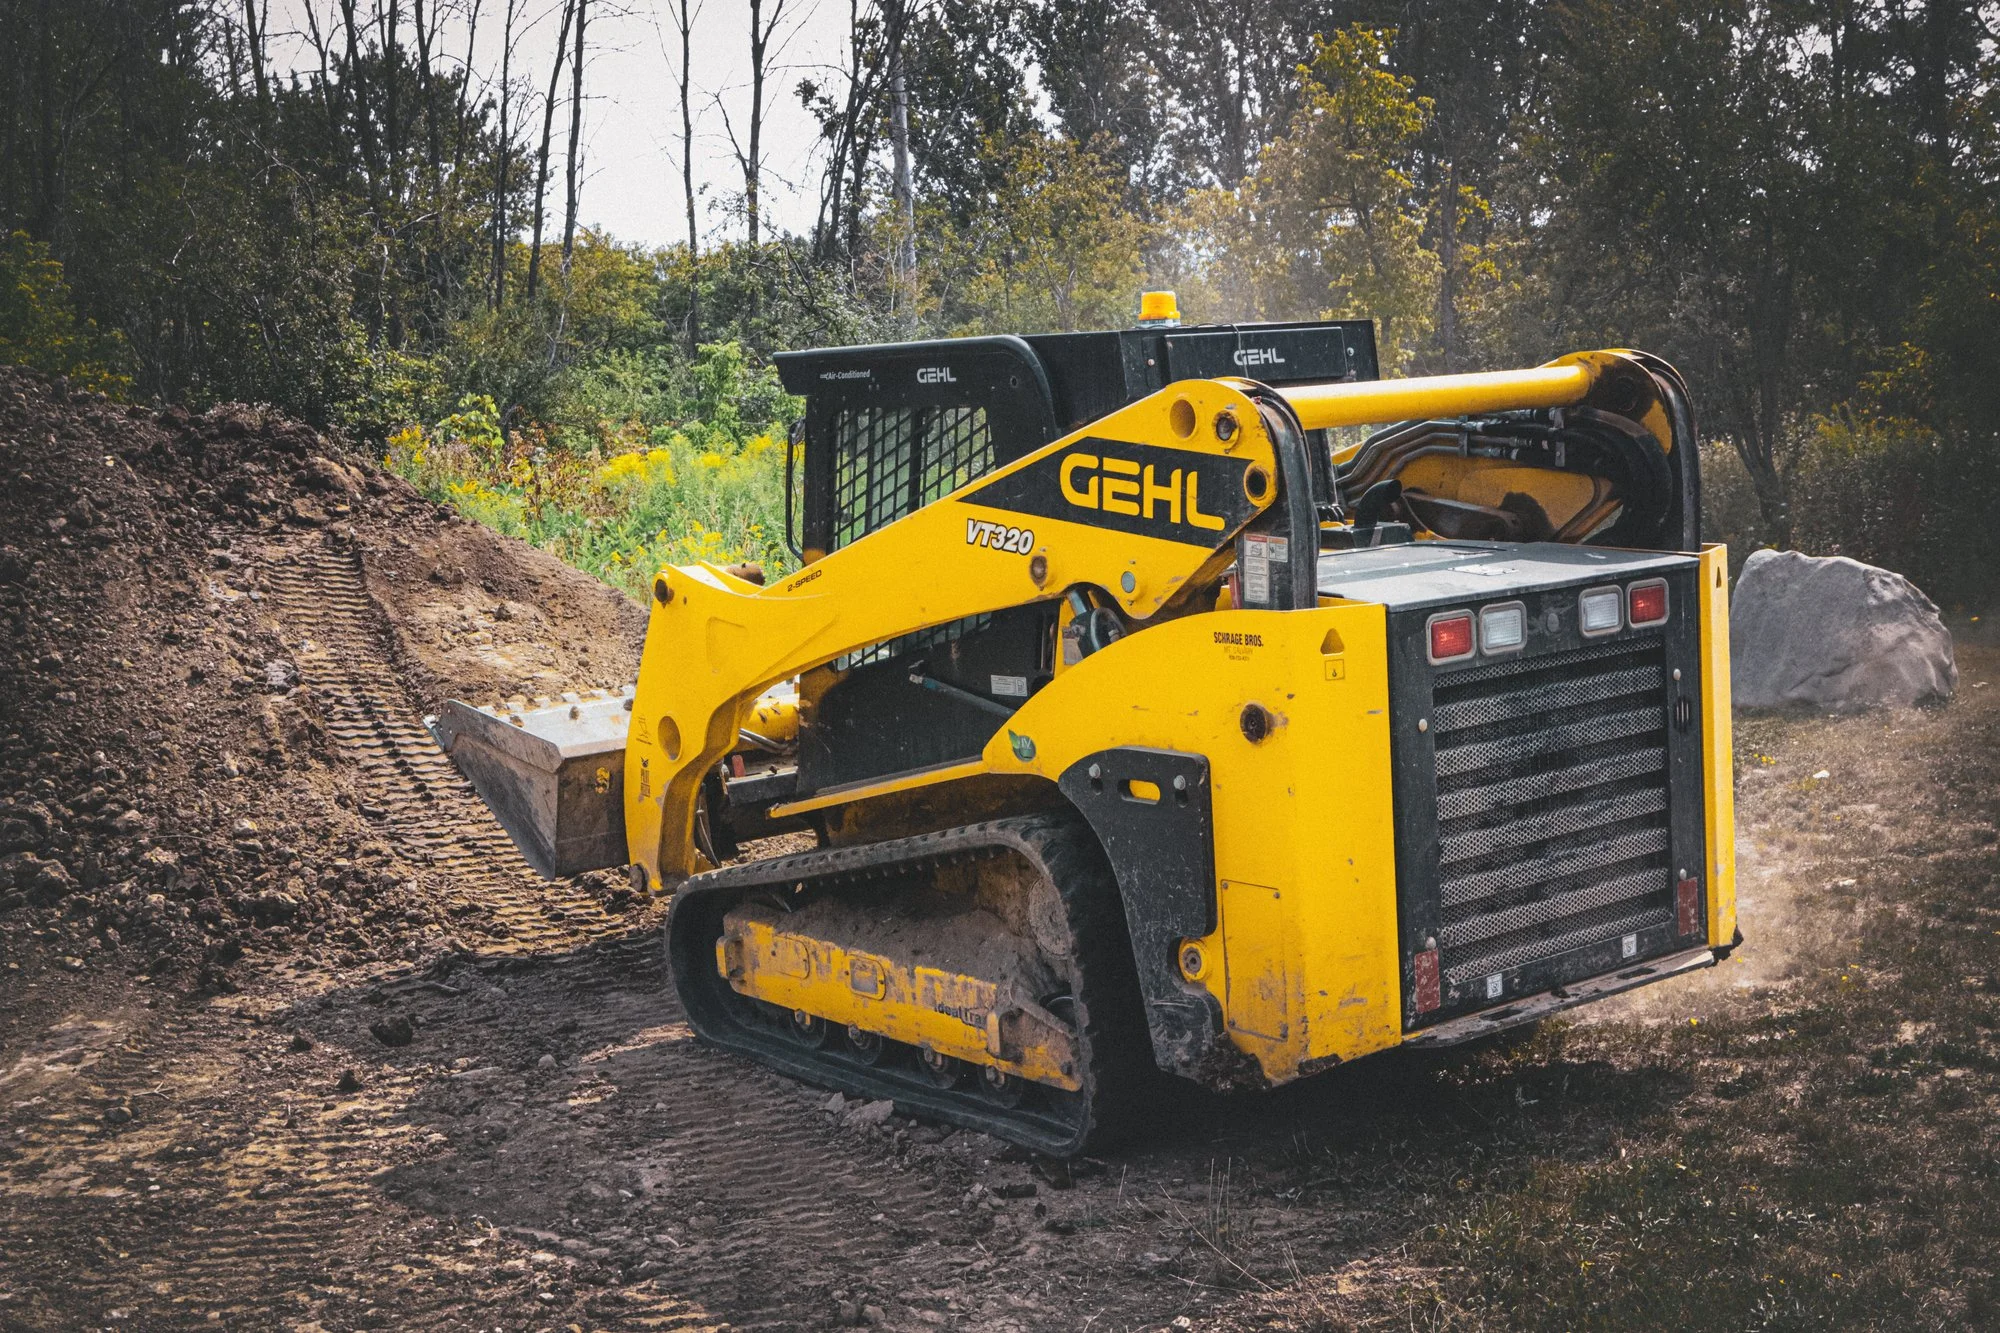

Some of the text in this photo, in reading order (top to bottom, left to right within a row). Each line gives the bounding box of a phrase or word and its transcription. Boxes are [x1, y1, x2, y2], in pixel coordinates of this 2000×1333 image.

[1233, 347, 1286, 366] GEHL
[916, 367, 957, 383] GEHL
[1059, 452, 1226, 531] GEHL
[966, 518, 1035, 556] VT320
[787, 569, 822, 592] 2-SPEED
[1213, 631, 1264, 647] SCHRAGE BROS.
